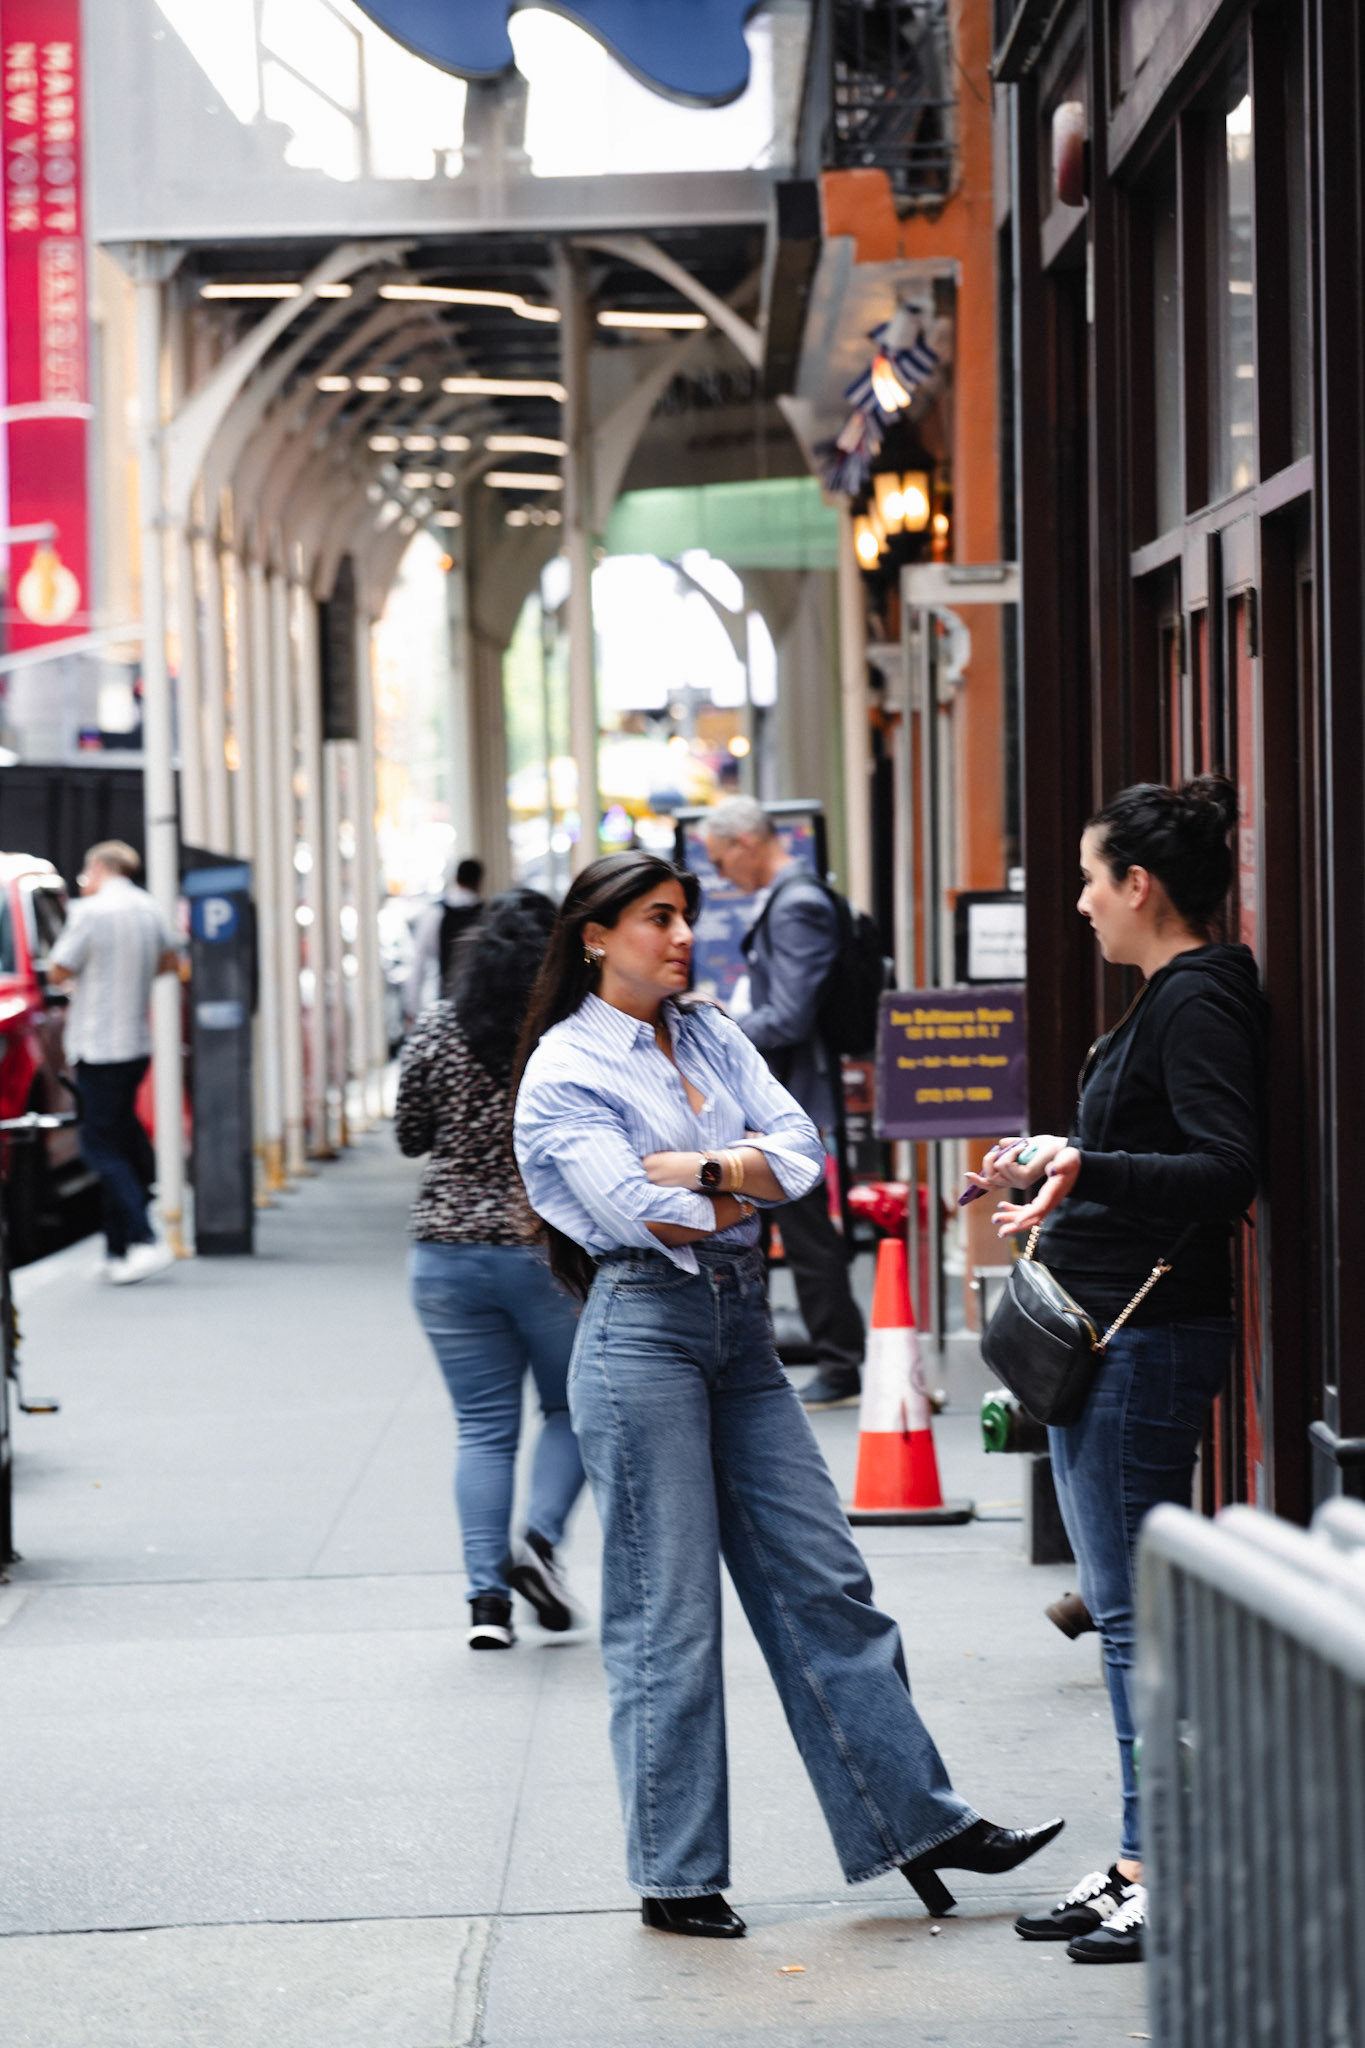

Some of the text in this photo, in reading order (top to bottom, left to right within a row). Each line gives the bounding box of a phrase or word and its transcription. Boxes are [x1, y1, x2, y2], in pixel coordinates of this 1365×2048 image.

[5, 41, 40, 232] NEW YORK
[41, 41, 76, 233] MARRIOTT
[202, 897, 233, 940] P
